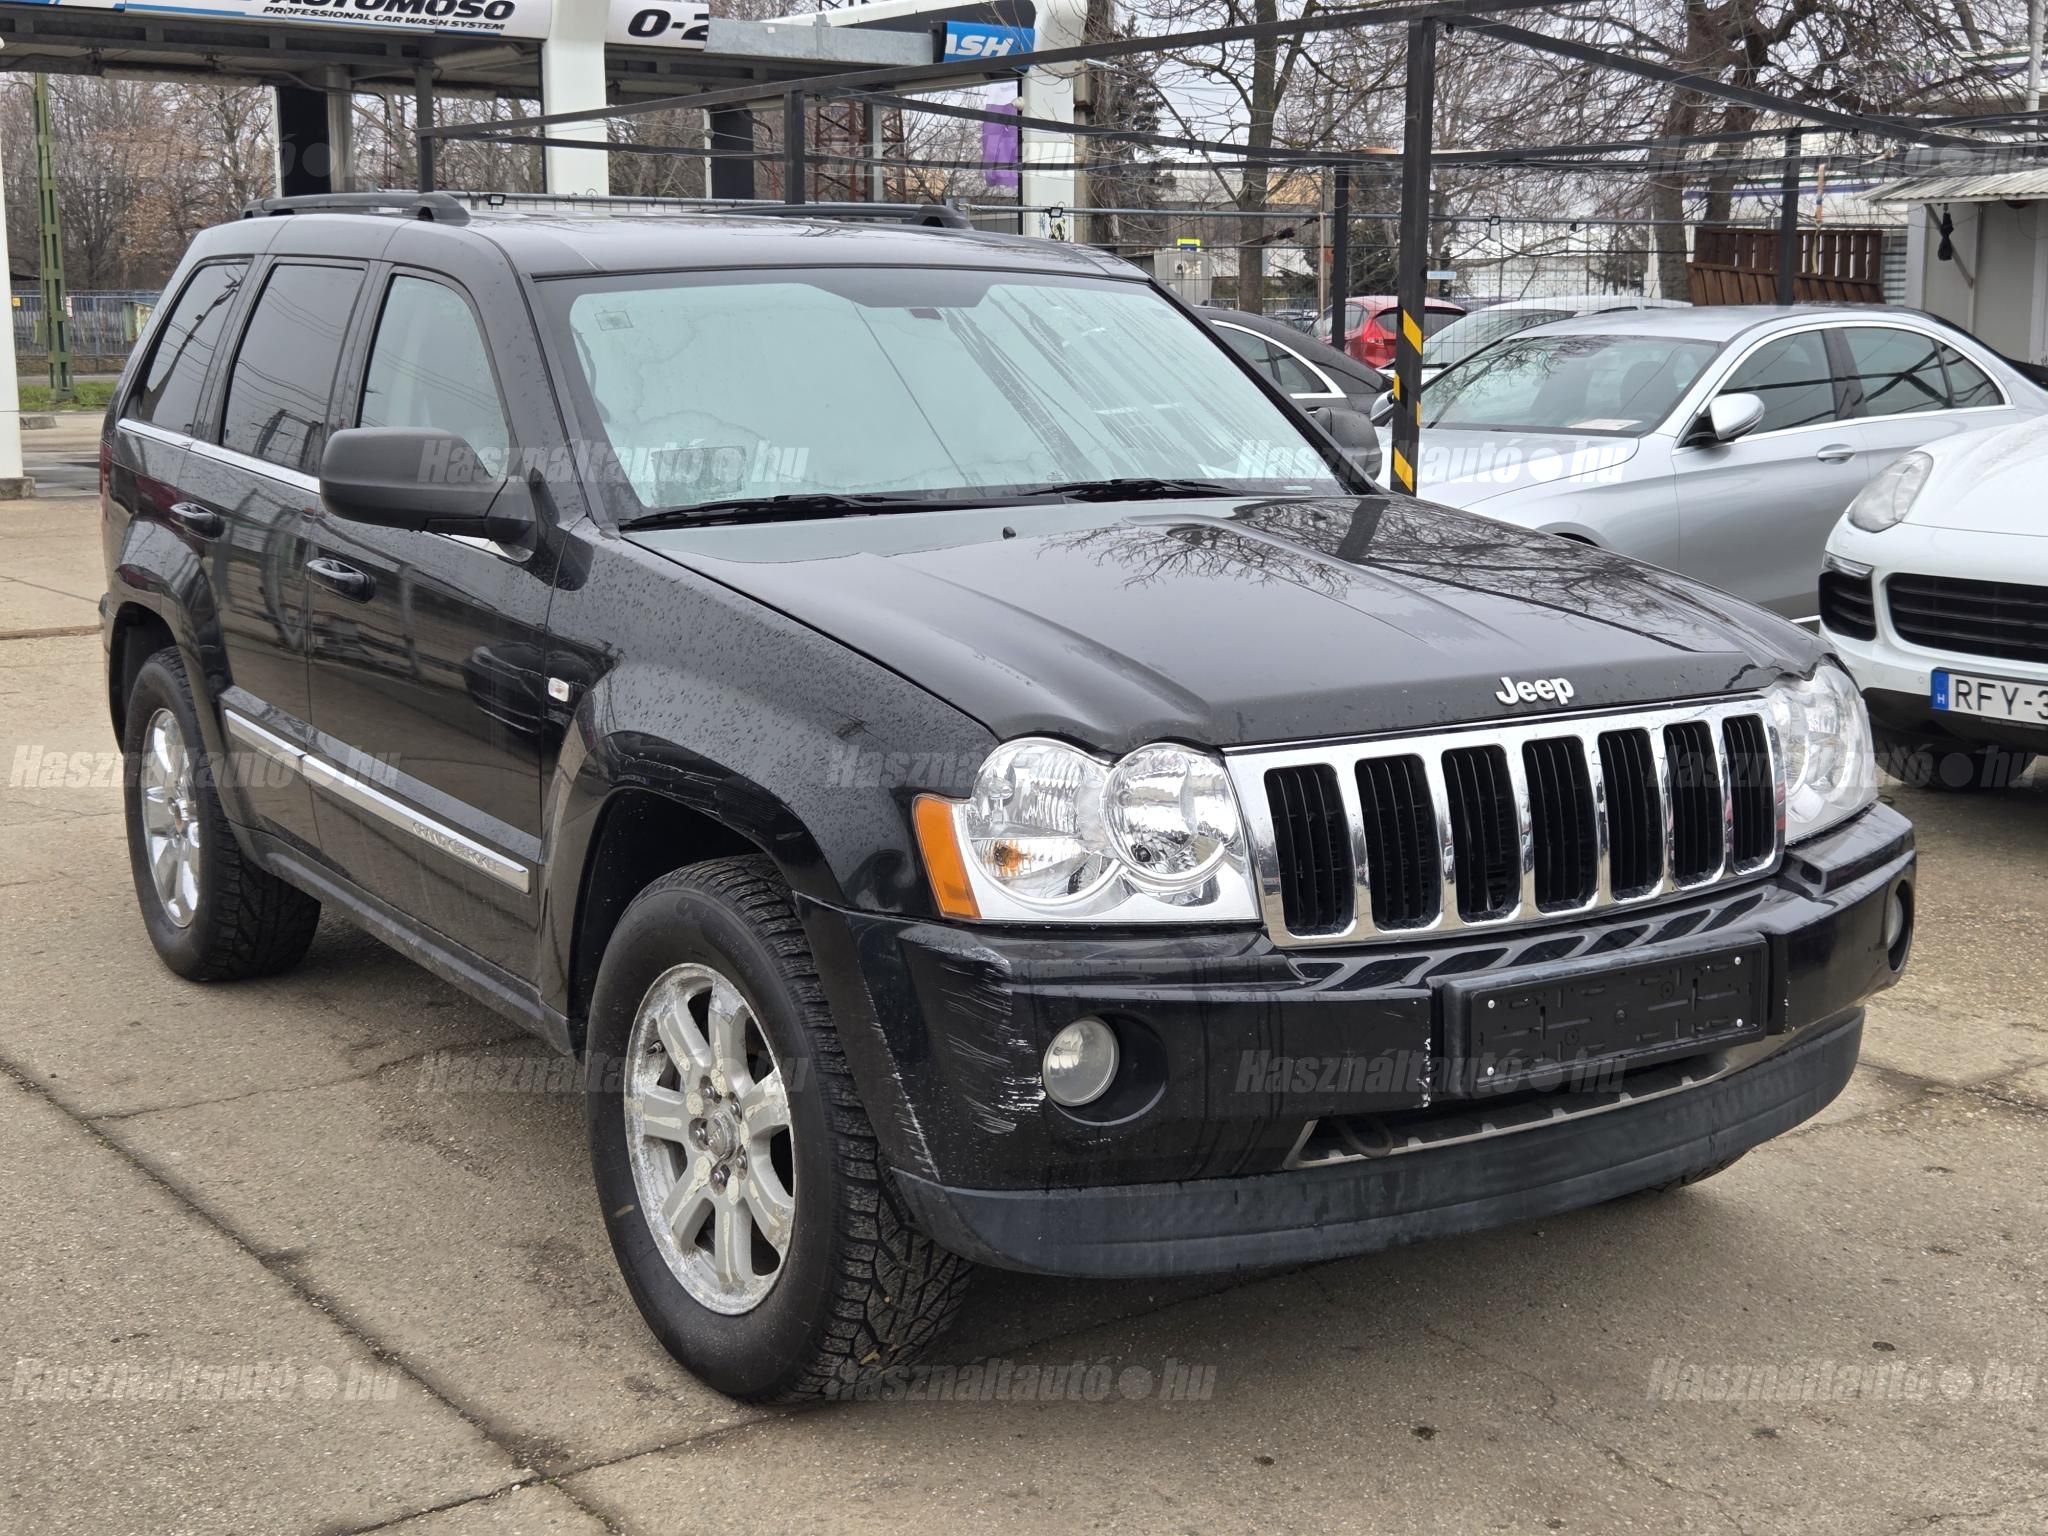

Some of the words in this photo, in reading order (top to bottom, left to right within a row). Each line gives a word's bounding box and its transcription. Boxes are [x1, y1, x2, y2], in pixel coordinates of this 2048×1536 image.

[263, 6, 371, 20] PROFESSIONAL
[374, 15, 403, 23] CAR
[405, 17, 447, 26] WASH
[450, 20, 505, 30] SYSTEM
[270, 0, 515, 20] OMOSO
[1495, 676, 1575, 705] Jeep
[1954, 679, 2048, 720] RFY-3
